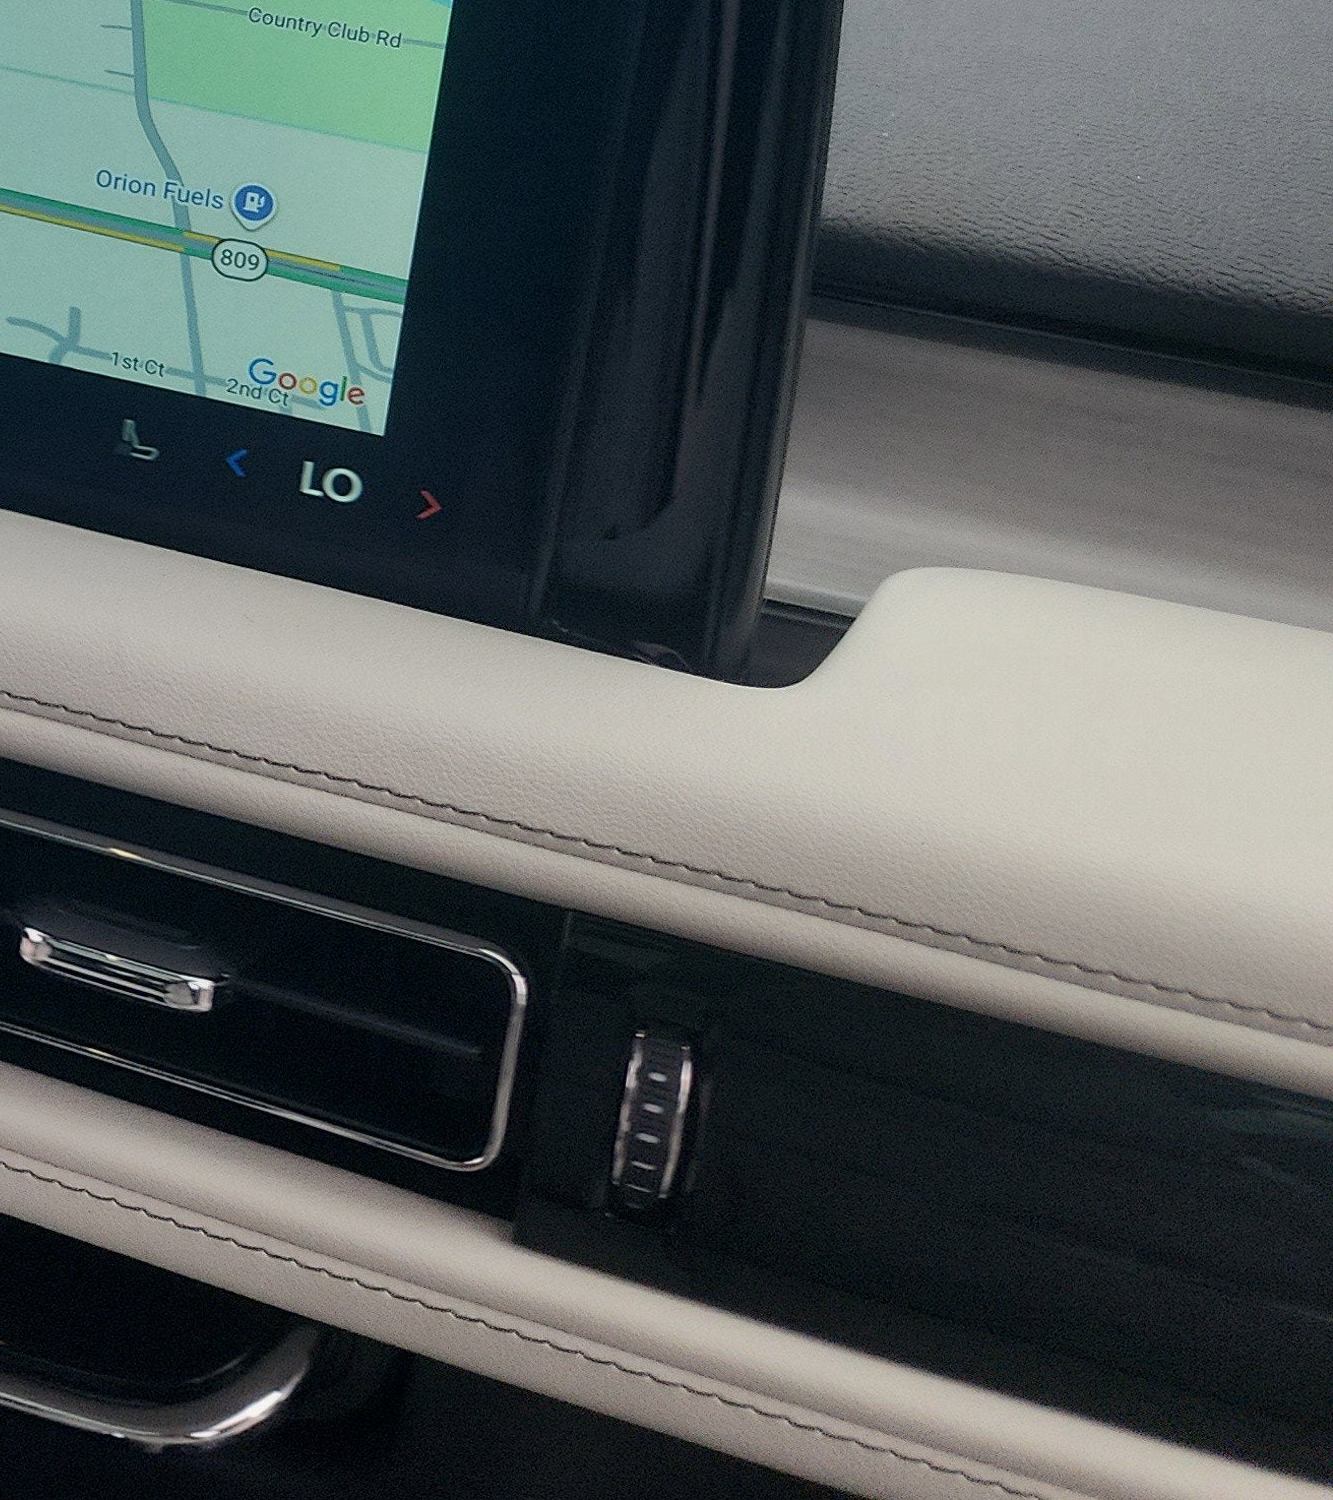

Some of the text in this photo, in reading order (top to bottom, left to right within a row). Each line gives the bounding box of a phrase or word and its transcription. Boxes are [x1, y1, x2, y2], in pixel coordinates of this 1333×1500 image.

[247, 6, 403, 49] Country Club Rd
[95, 169, 225, 210] Orion Fuels
[219, 248, 261, 271] 809
[110, 351, 166, 378] 1st Ct
[248, 357, 366, 407] Google
[225, 377, 290, 407] 2nd Ct
[299, 460, 364, 503] LO
